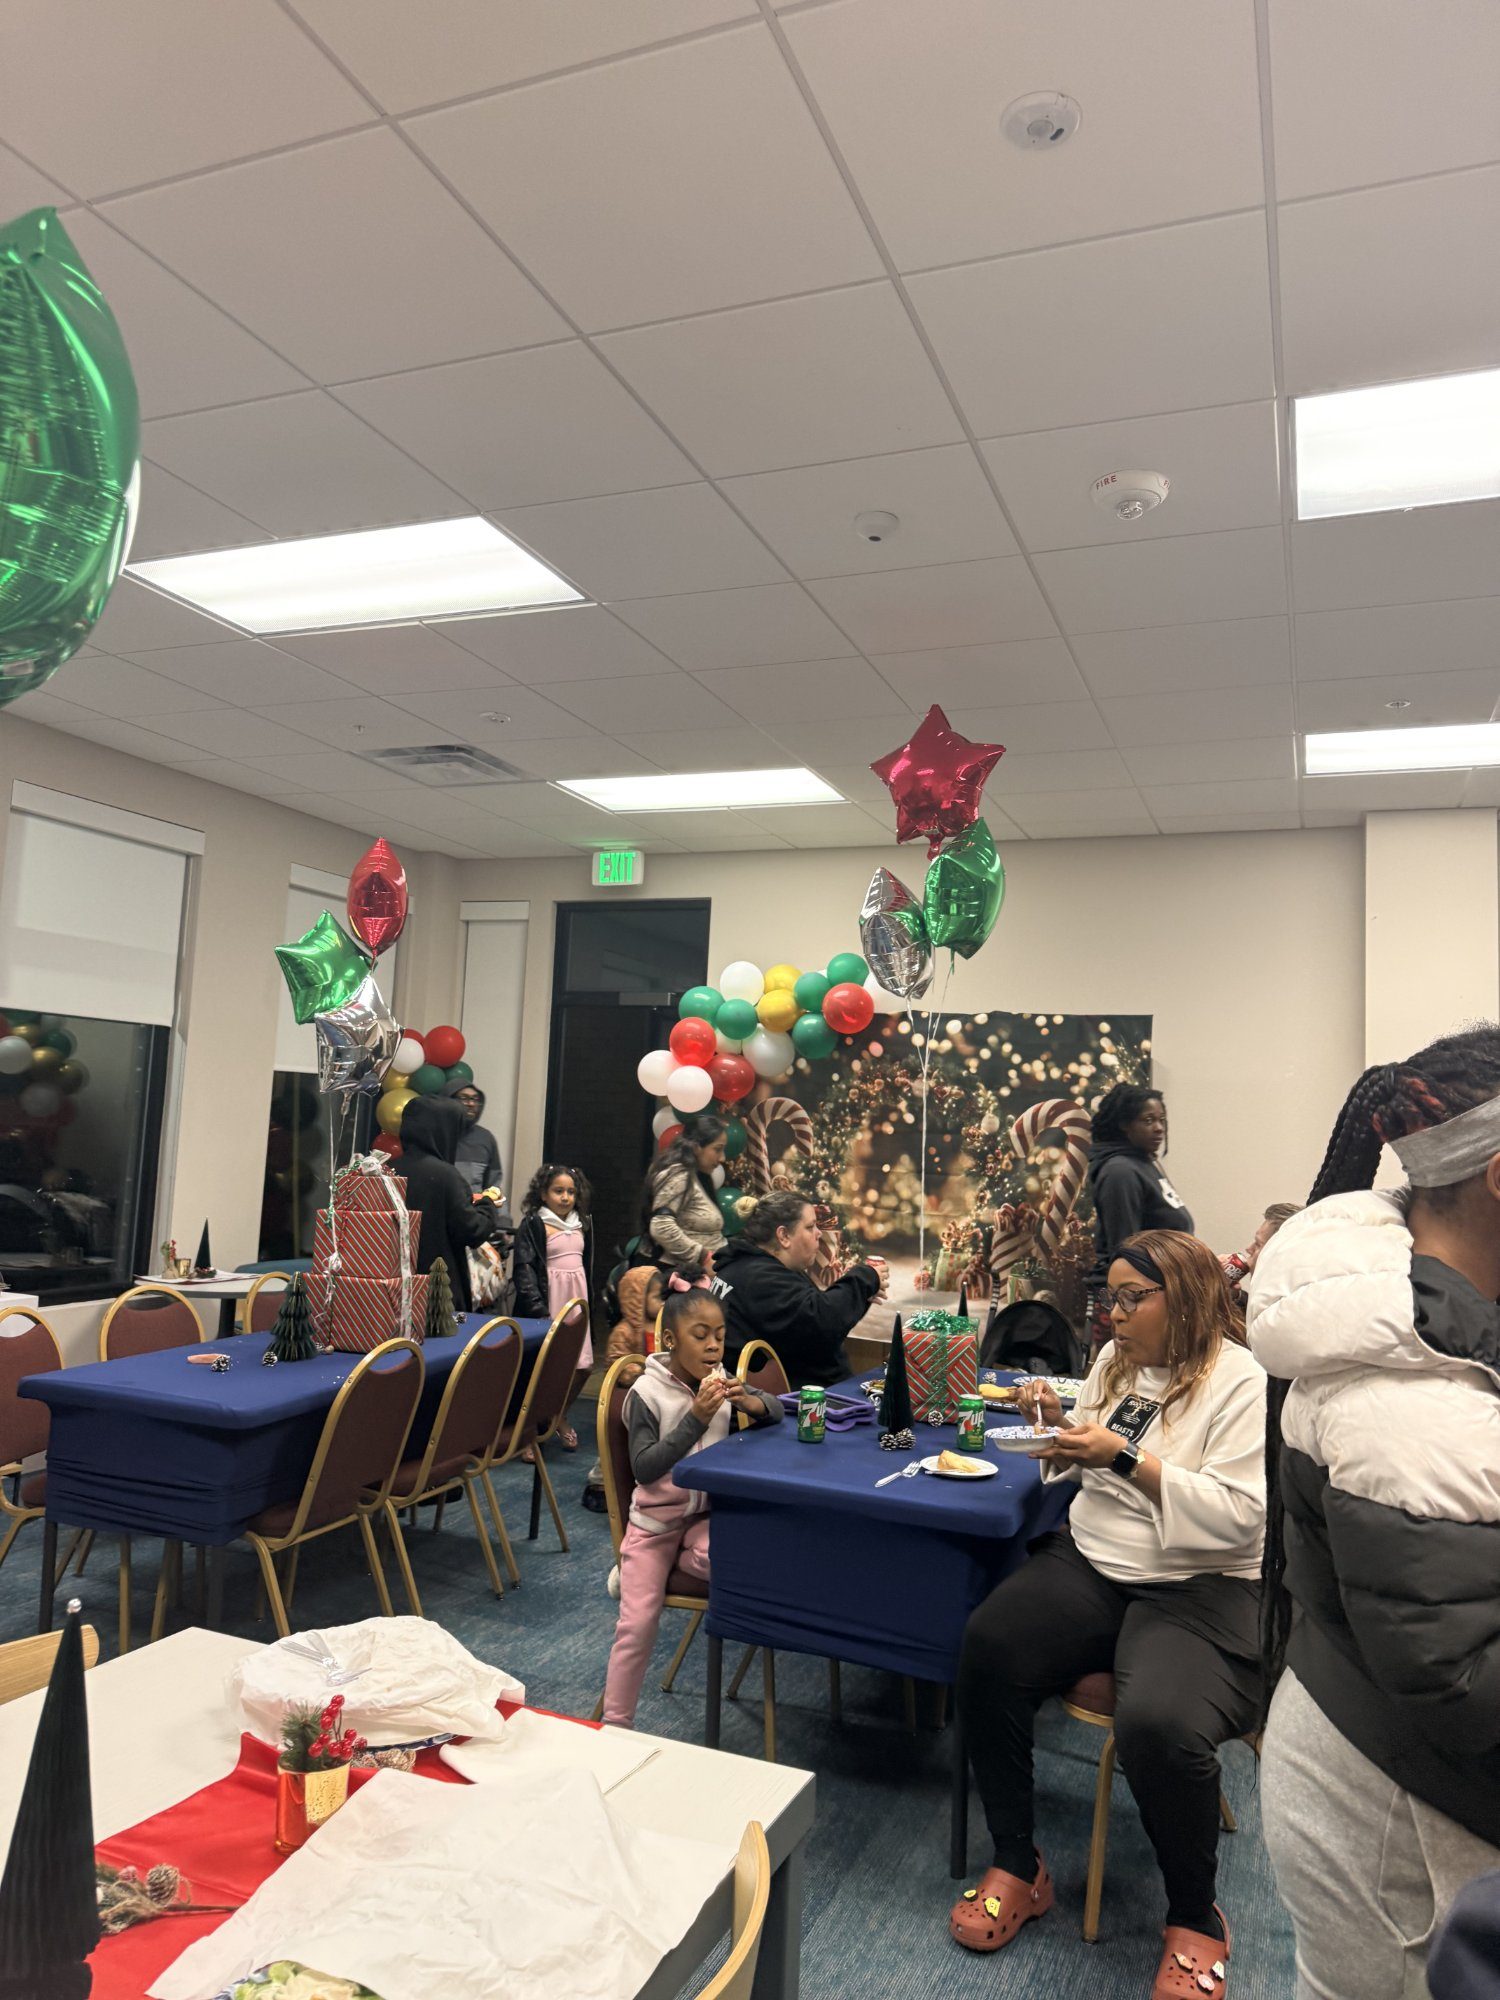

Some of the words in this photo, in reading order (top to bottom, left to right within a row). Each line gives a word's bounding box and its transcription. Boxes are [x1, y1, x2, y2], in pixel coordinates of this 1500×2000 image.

[1096, 475, 1117, 490] FIRE
[599, 852, 636, 883] EXIT
[1110, 1423, 1135, 1437] BEASTS
